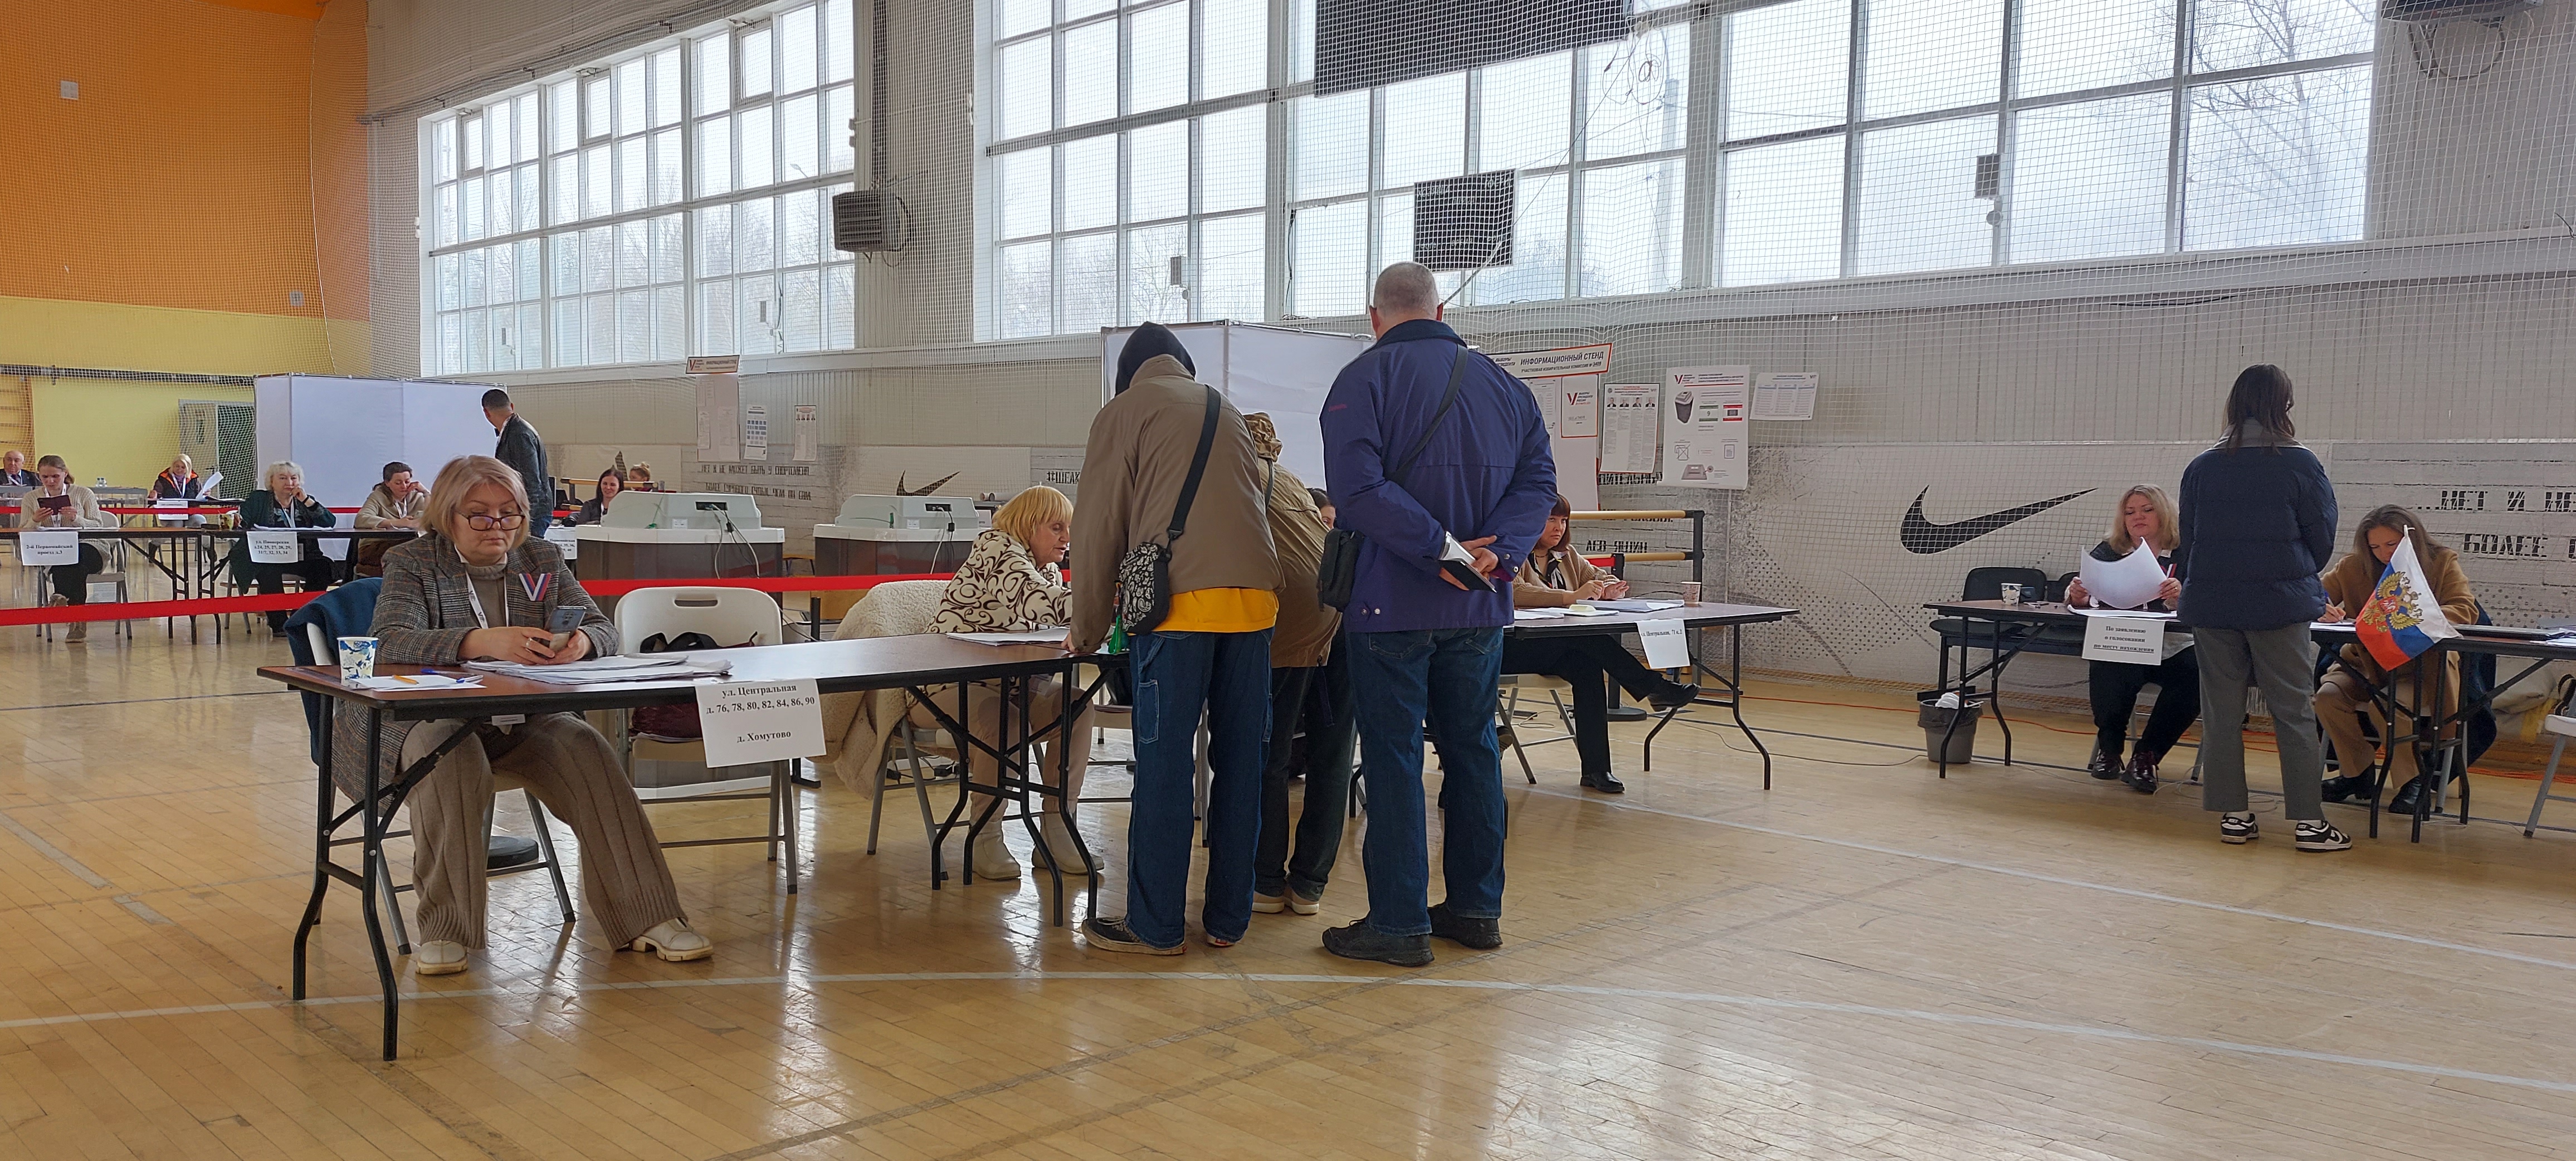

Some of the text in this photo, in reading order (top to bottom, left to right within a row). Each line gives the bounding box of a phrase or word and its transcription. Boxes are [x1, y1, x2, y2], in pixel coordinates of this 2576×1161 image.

[1520, 351, 1604, 365] ИНФОРМАЦИОННЫЙ СТЕНД
[2507, 491, 2525, 511] И
[2463, 533, 2549, 558] БОЛЕЕ
[722, 685, 797, 699] ул. Центральная
[716, 704, 729, 713] 76,
[731, 703, 745, 712] 78,
[747, 701, 760, 711] 80,
[762, 700, 775, 709] 82,
[777, 699, 789, 708] 84,
[791, 697, 804, 706] 86,
[805, 696, 815, 705] 90
[747, 731, 791, 742] Хомутово
